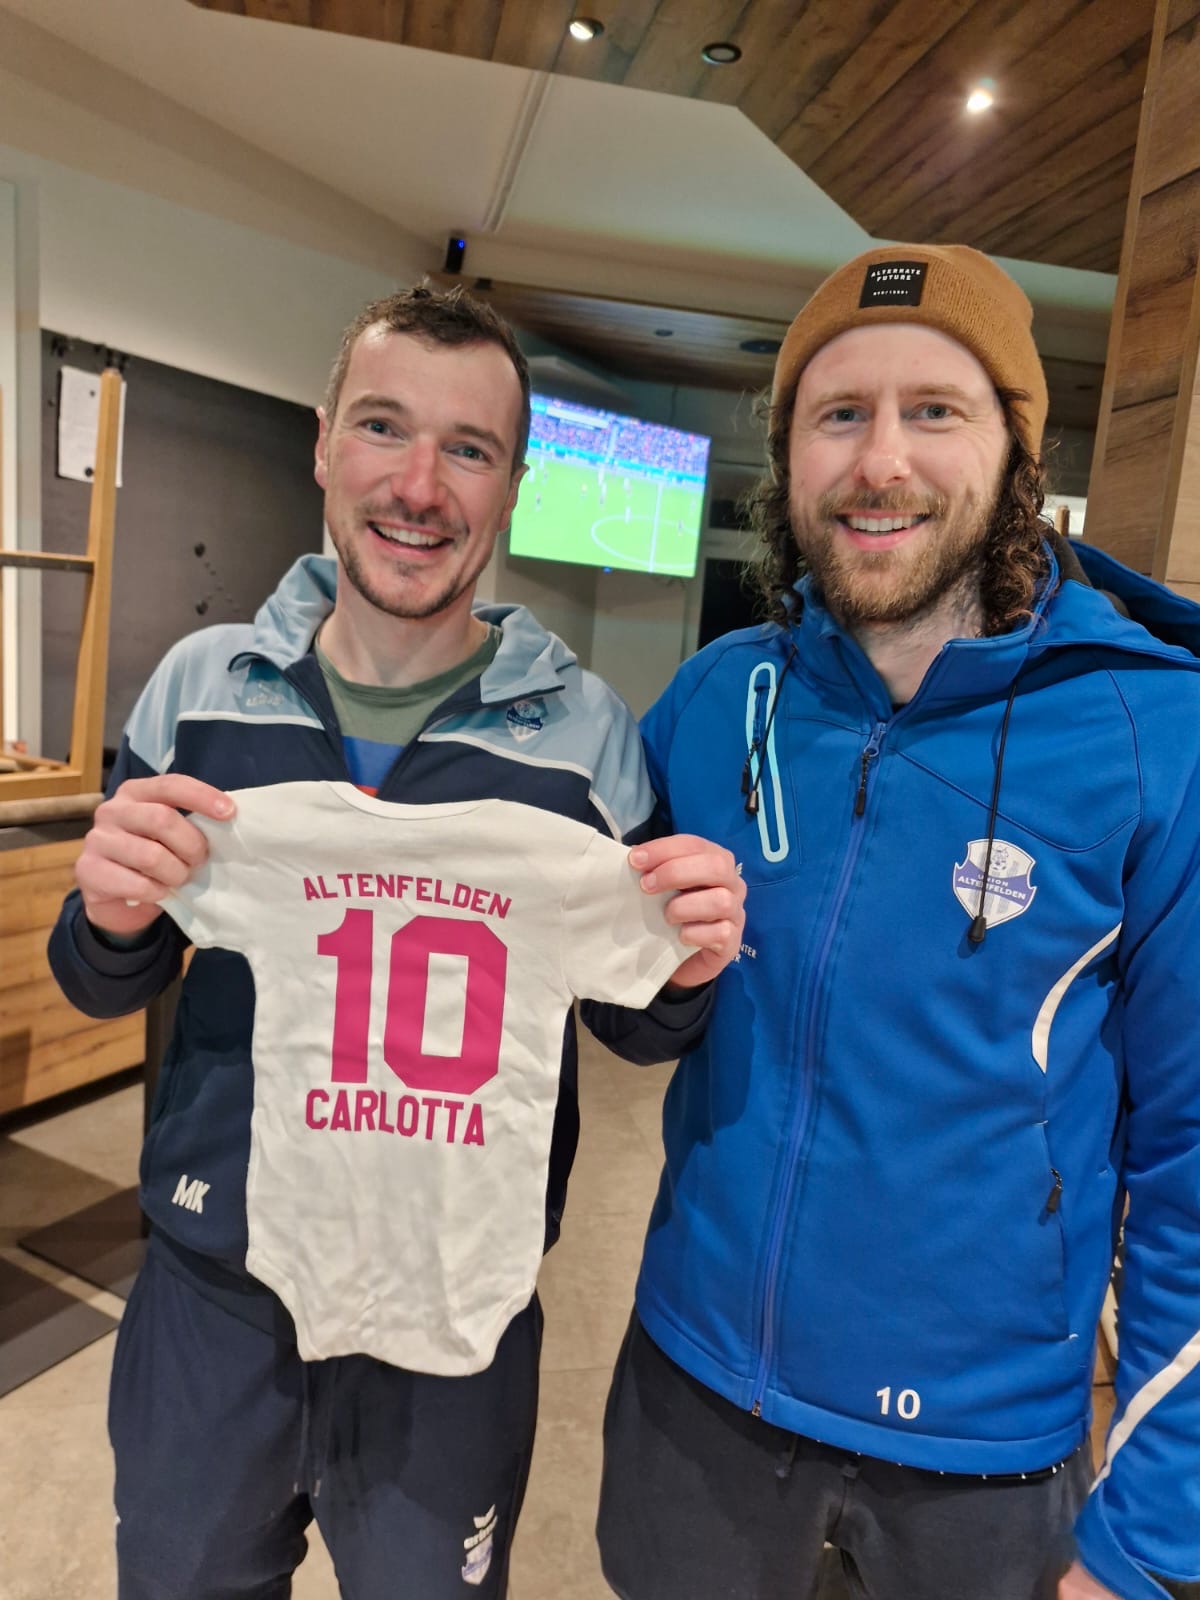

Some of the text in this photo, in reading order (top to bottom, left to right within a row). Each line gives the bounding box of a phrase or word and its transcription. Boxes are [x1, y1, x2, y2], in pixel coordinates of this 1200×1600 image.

[871, 268, 921, 277] ALTERNATE
[876, 274, 911, 282] FUTURE
[303, 873, 512, 919] ALTENFELDEN
[317, 907, 508, 1096] 10
[305, 1089, 485, 1146] CARLOTTA
[171, 1174, 211, 1214] MK
[876, 1386, 921, 1420] 10
